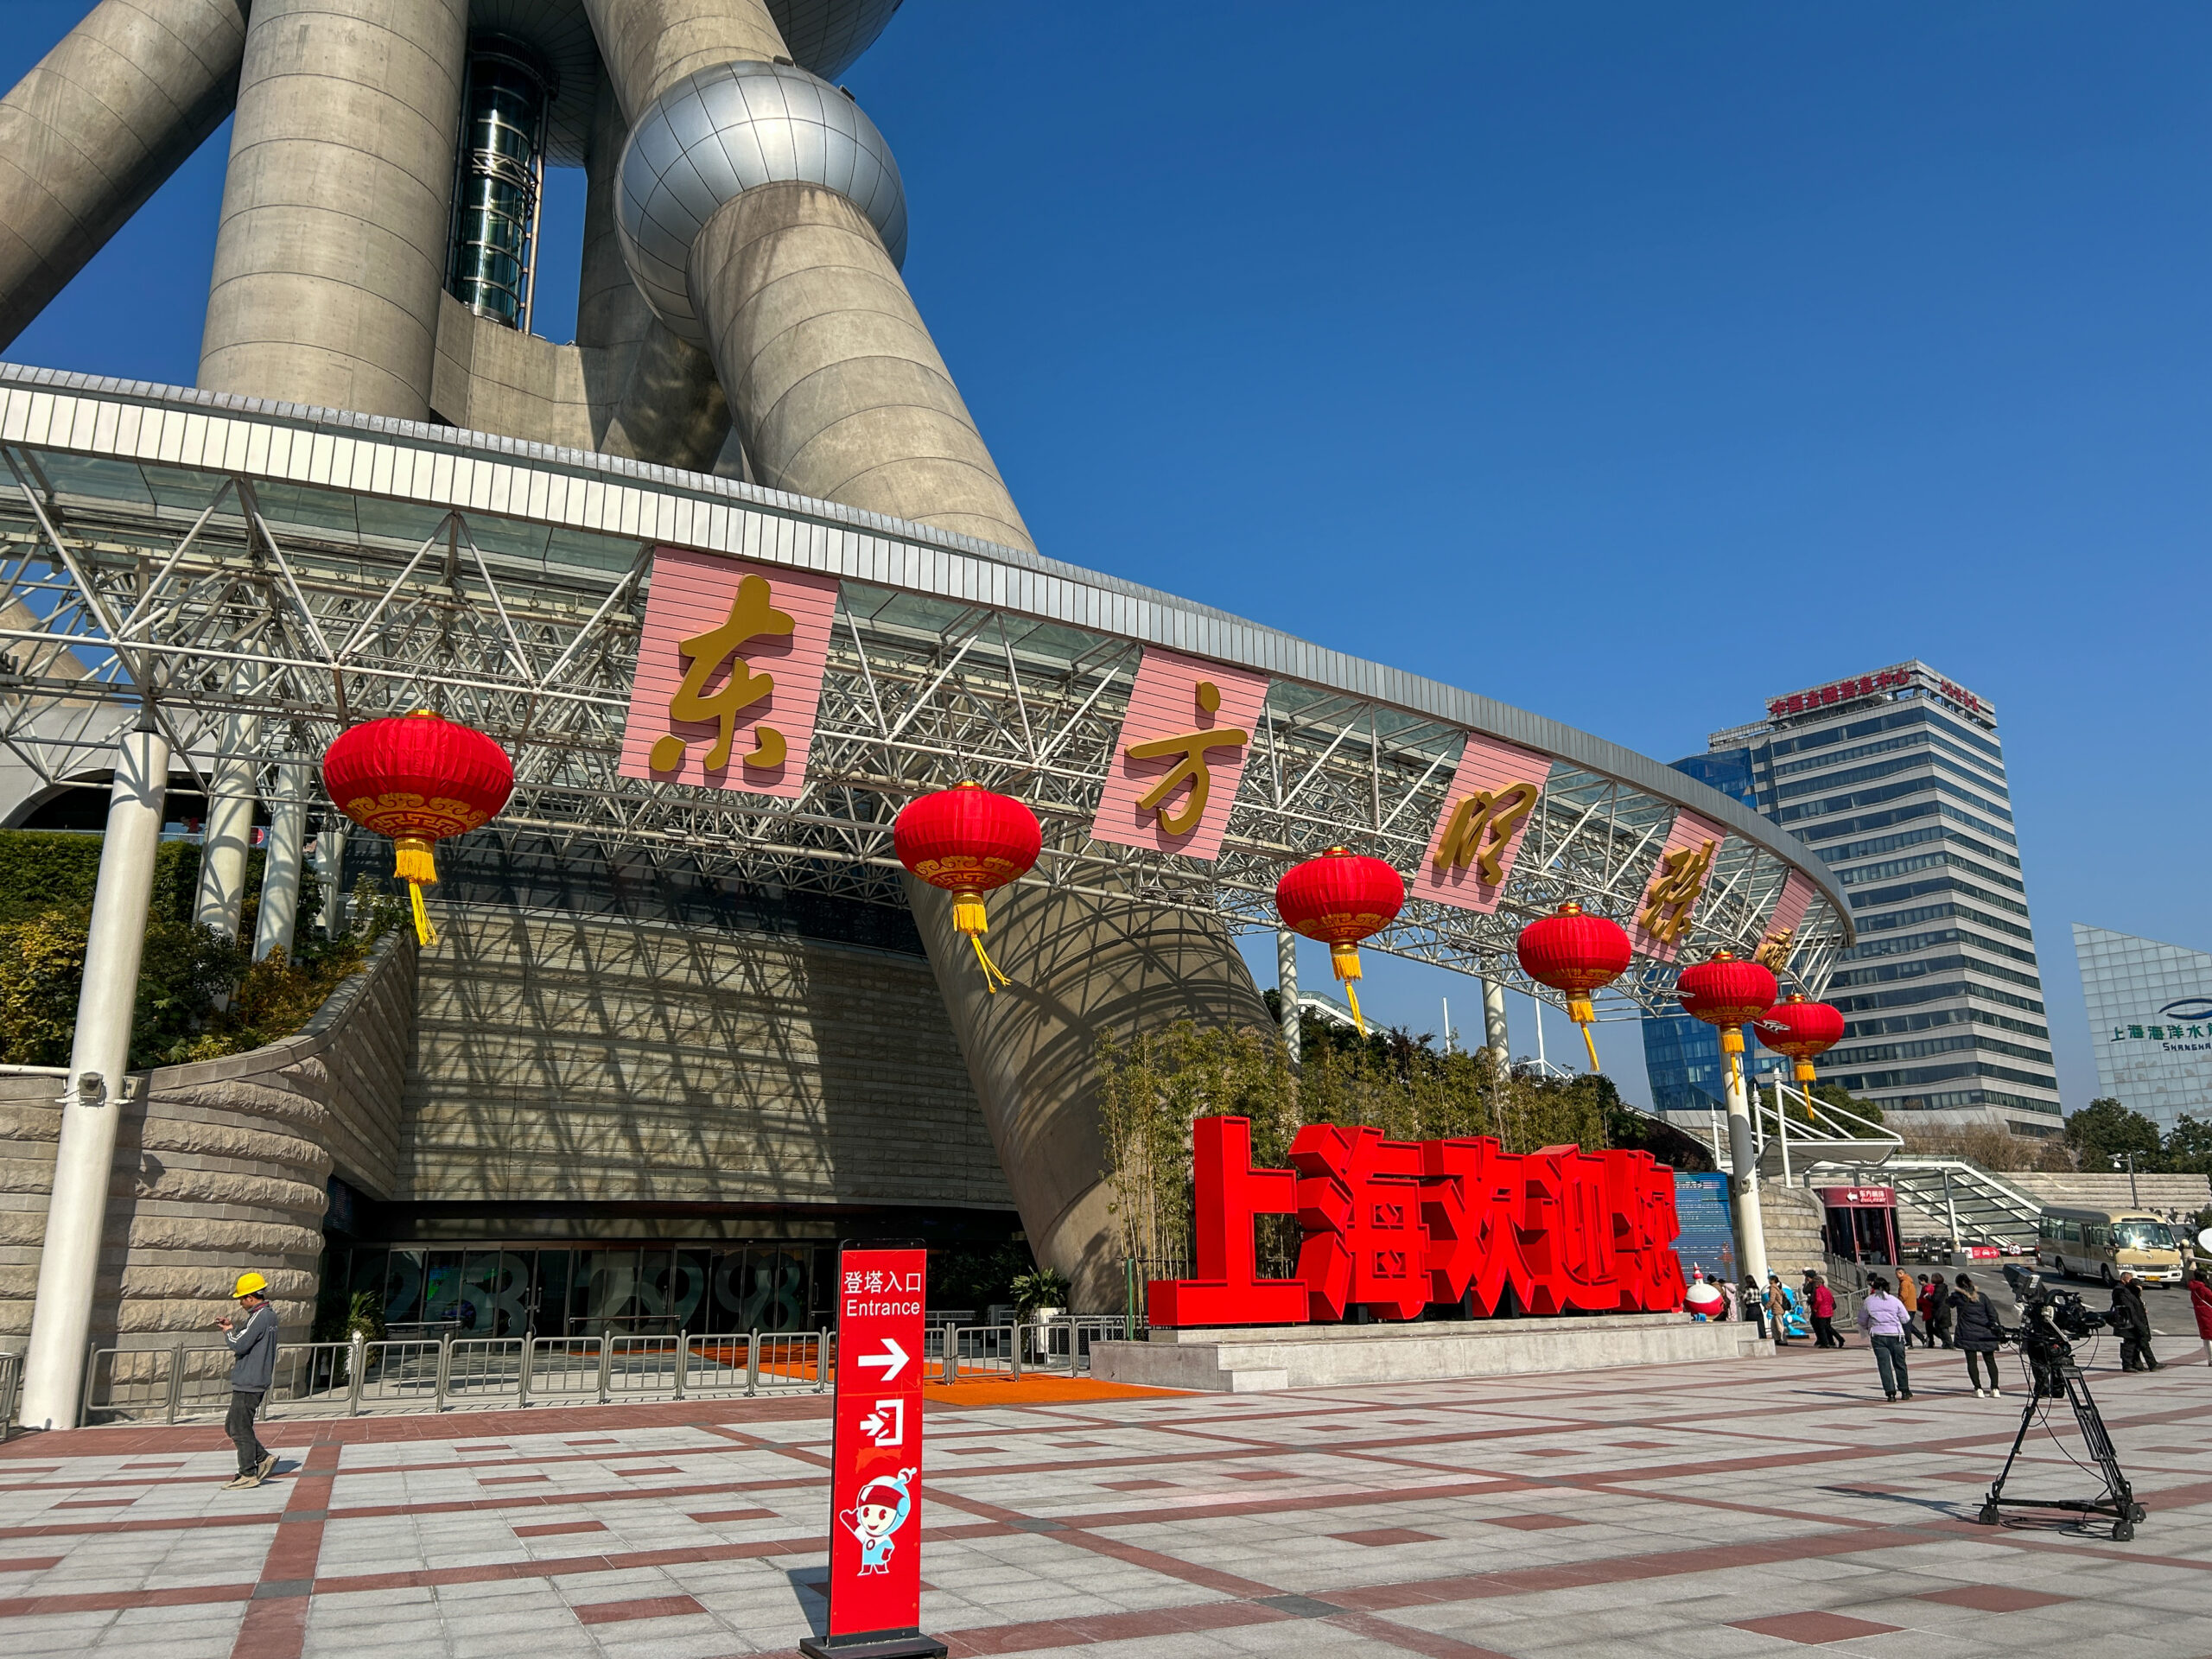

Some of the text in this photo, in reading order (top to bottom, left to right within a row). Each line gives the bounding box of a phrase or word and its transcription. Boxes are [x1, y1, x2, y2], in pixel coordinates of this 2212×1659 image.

[1771, 668, 1910, 717] 中国金融信息中心
[1148, 1116, 1688, 1325] 上海欢迎您
[844, 1270, 921, 1294] 登塔入口
[847, 1299, 920, 1316] Entrance
